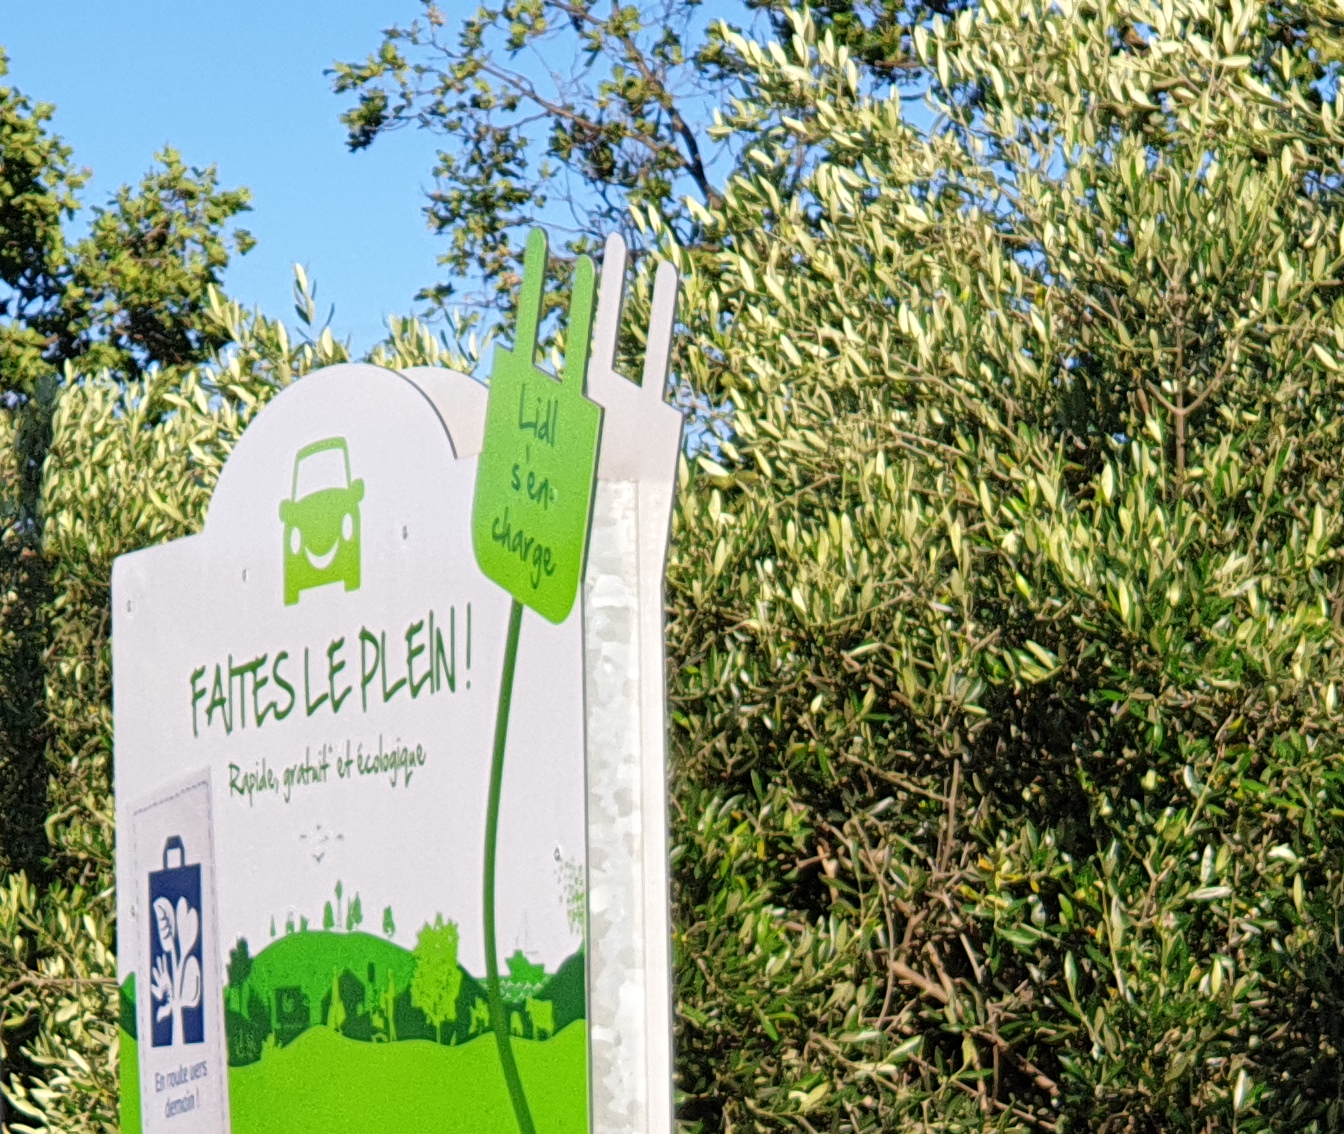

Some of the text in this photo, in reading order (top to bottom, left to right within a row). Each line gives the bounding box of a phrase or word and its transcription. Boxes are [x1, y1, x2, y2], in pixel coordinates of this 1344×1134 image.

[519, 383, 558, 447] Lidl
[491, 507, 556, 590] charge
[190, 650, 295, 737] FAITES
[304, 637, 352, 717] LE
[228, 757, 279, 808] Rapide,
[337, 739, 354, 779] et
[357, 733, 426, 788] écologique
[167, 1064, 188, 1087] route
[190, 1060, 208, 1080] vers
